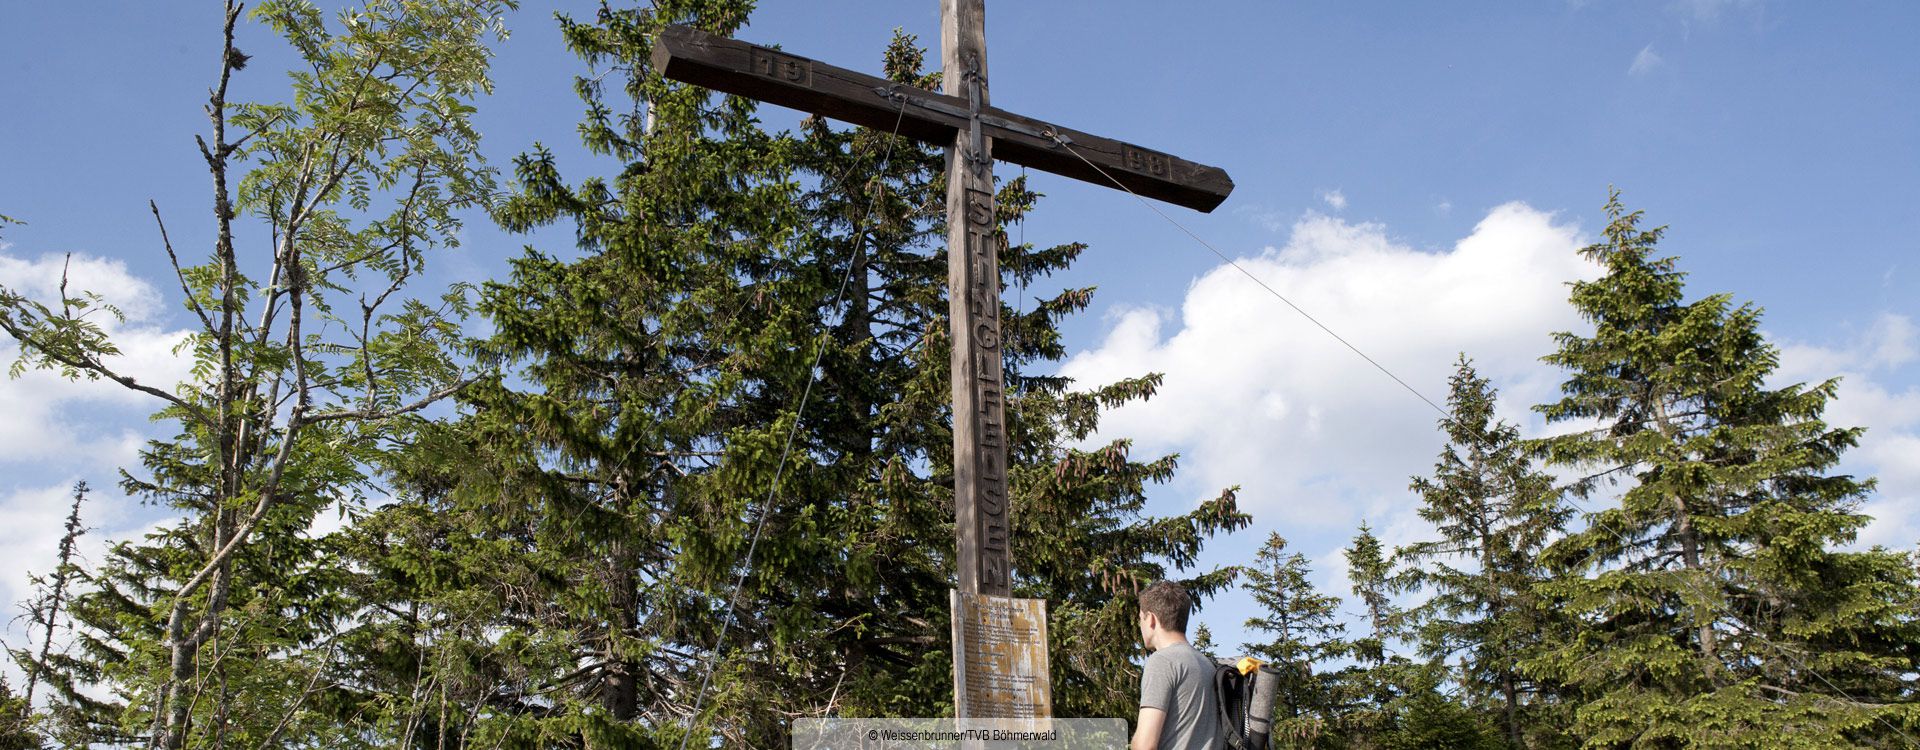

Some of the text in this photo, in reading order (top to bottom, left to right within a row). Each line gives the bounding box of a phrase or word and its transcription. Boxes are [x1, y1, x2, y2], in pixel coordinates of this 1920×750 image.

[761, 56, 1164, 175] 19 98
[969, 201, 1006, 587] STINGLFELSEN
